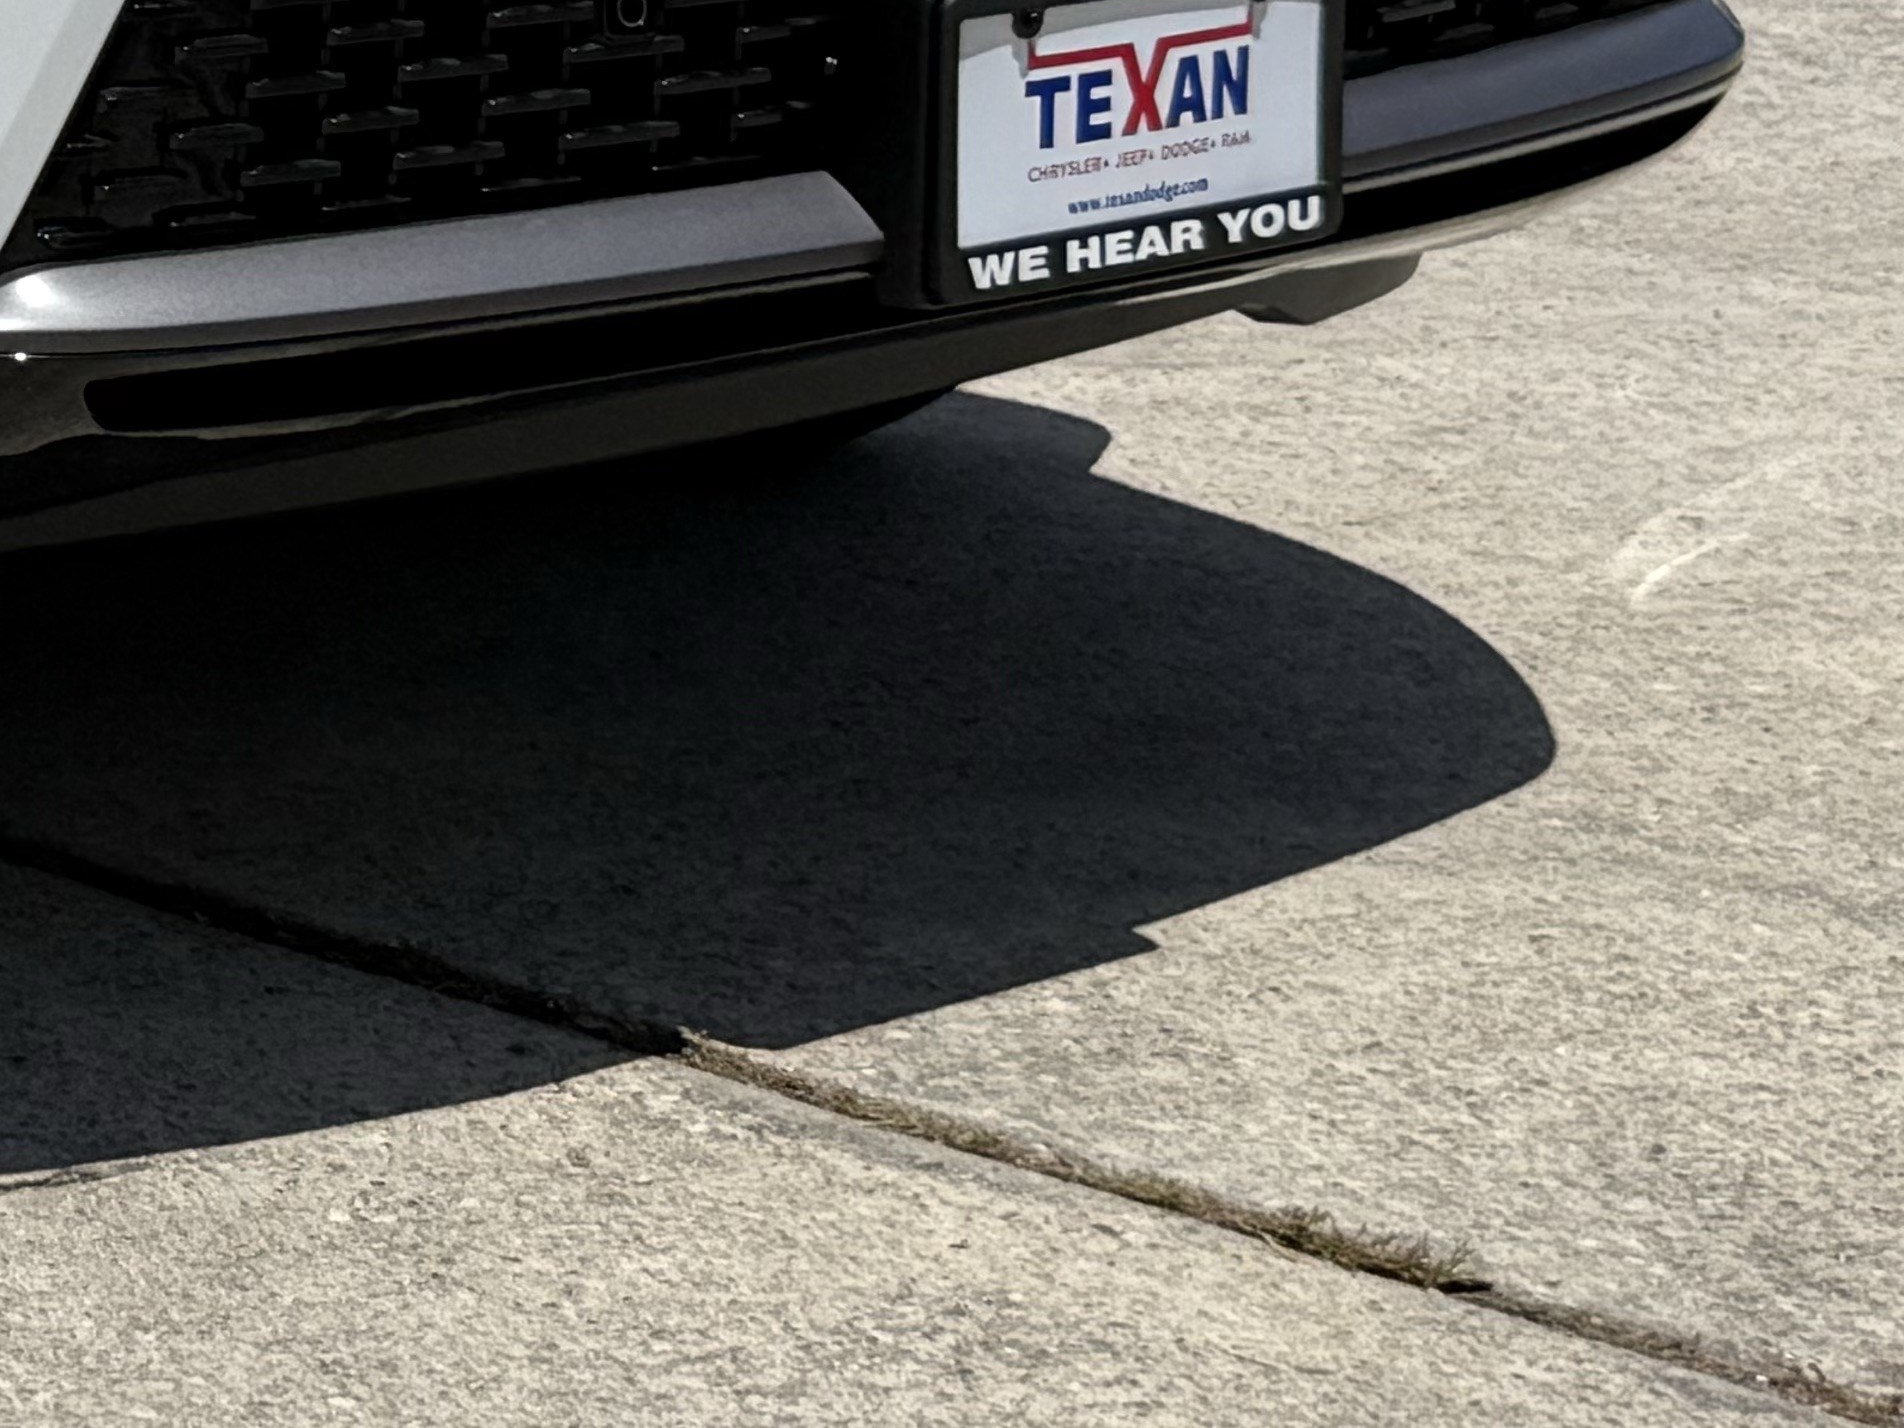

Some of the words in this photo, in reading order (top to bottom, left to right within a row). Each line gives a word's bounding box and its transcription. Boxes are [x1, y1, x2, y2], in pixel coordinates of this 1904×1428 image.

[1024, 29, 1251, 149] TEXAN
[1160, 136, 1210, 160] DODGE
[967, 245, 1050, 291] WE
[1065, 217, 1205, 274] HEAR
[1216, 194, 1322, 244] YOU
